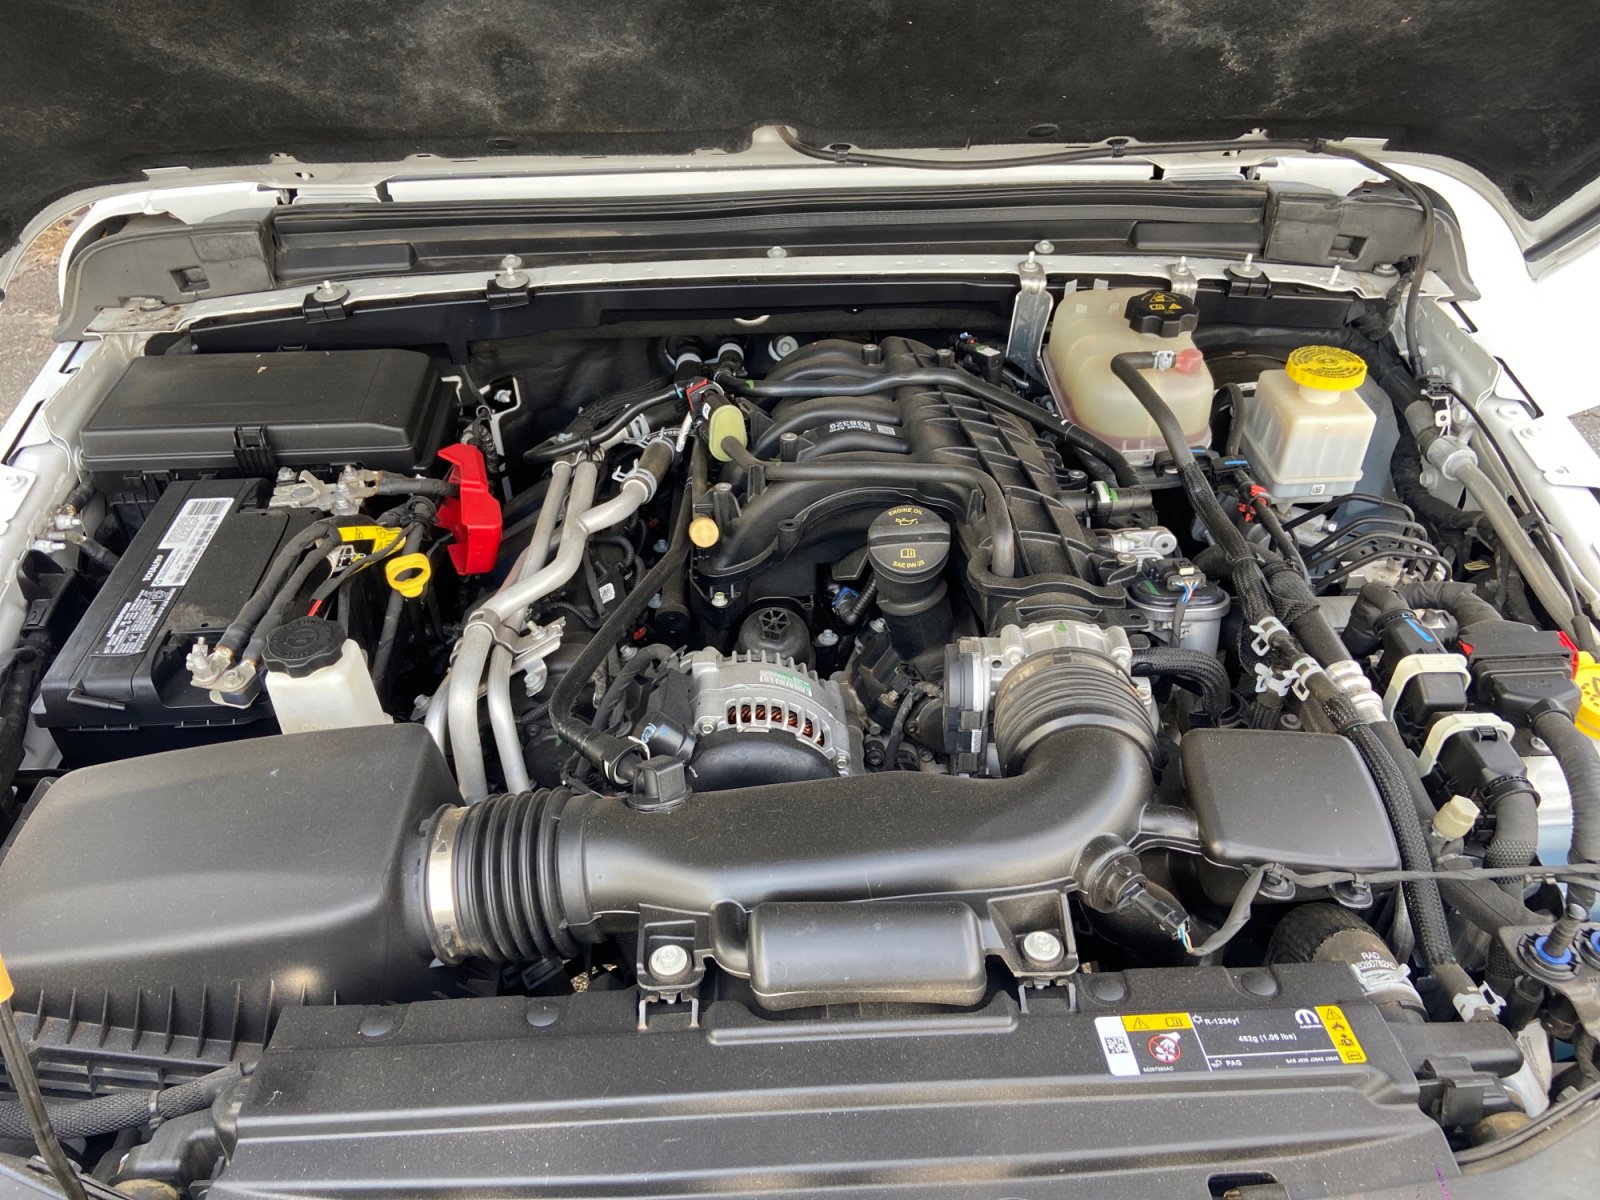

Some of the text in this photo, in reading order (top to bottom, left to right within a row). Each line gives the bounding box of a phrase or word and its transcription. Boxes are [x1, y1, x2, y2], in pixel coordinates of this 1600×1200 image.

[888, 508, 923, 517] ENGINE OIL
[1361, 951, 1381, 960] RAD
[1204, 1016, 1240, 1026] R-1234yf
